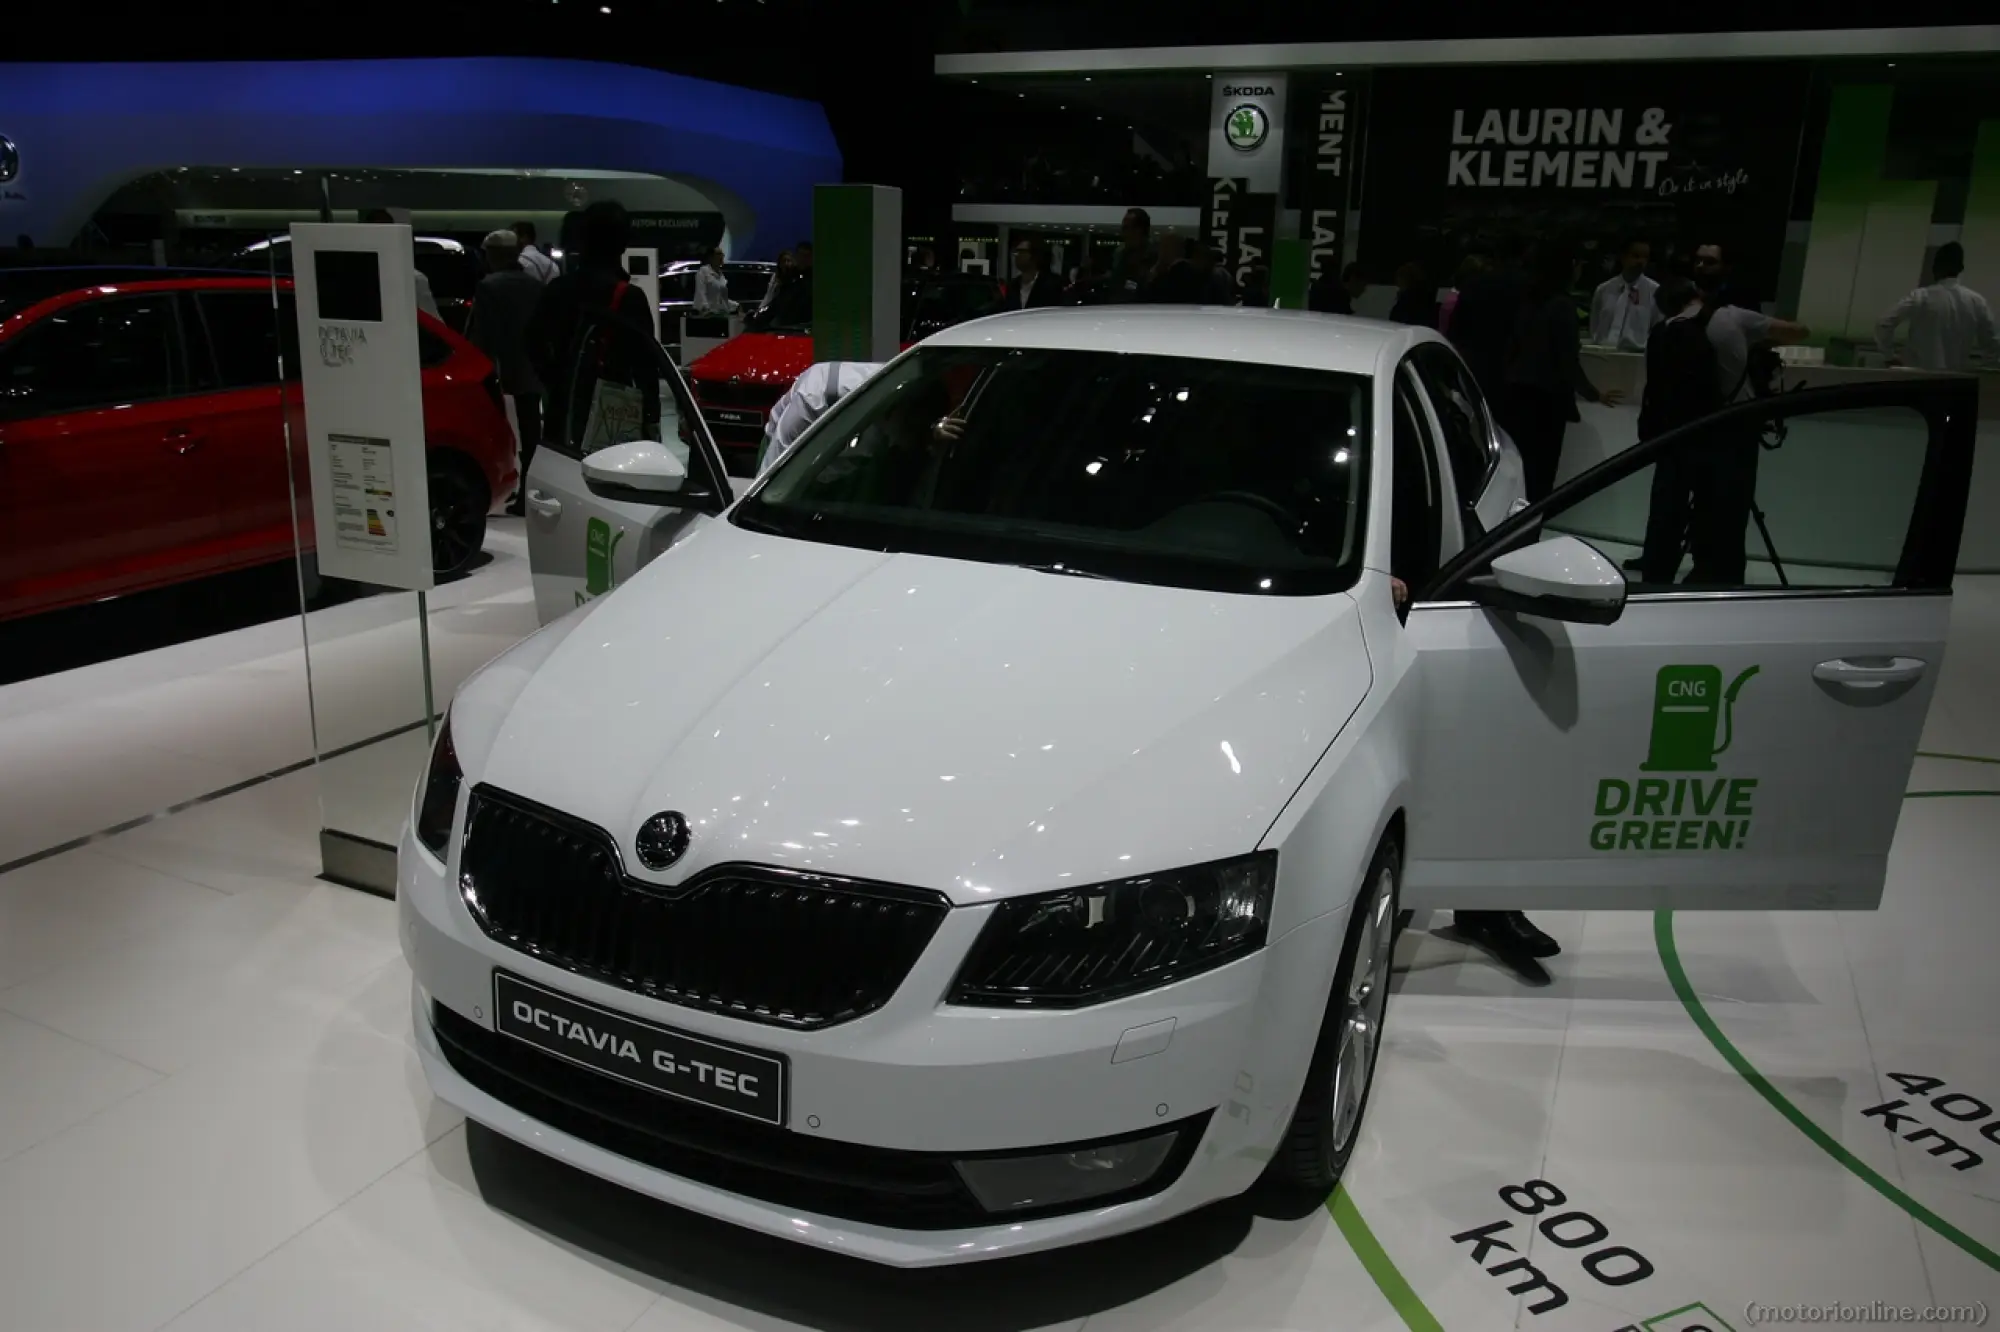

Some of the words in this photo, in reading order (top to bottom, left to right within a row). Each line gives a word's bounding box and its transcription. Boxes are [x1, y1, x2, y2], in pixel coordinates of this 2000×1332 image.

[1223, 84, 1275, 97] ŠKODA
[1316, 88, 1347, 177] MENT
[1450, 107, 1623, 146] LAURIN
[1634, 105, 1672, 146] &
[1446, 149, 1670, 189] KLEMENT
[1716, 167, 1750, 195] style
[1668, 680, 1706, 698] CNG
[1594, 778, 1758, 816] DRIVE
[1590, 819, 1750, 850] GREEN!
[512, 1000, 641, 1063] OCTAVIA
[652, 1050, 759, 1098] G-TEC
[1860, 1099, 1984, 1171] km
[1498, 1179, 1654, 1286] 800
[1450, 1220, 1569, 1315] km
